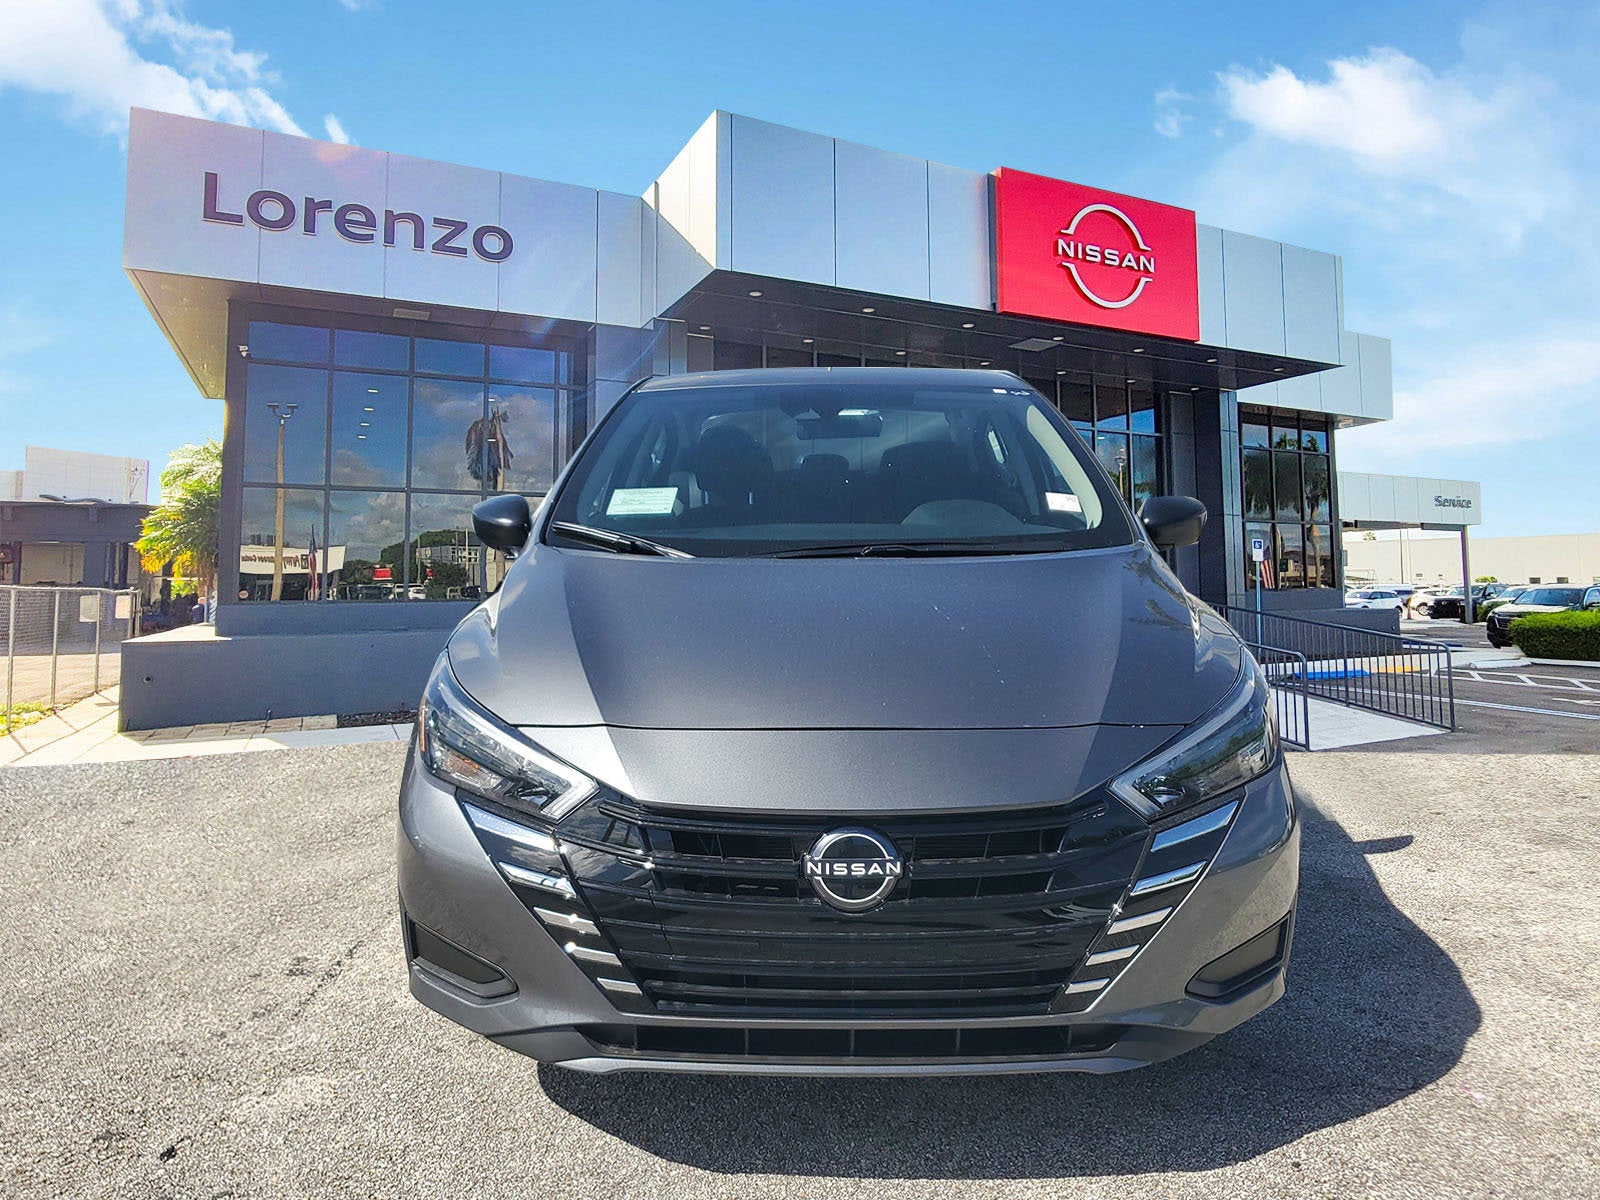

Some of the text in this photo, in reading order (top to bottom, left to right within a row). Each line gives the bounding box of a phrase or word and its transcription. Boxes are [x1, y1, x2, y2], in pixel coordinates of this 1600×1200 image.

[202, 171, 514, 262] Lorenzo
[1057, 238, 1155, 273] NISSAN
[1434, 495, 1472, 508] Service
[806, 861, 901, 875] NISSAN
